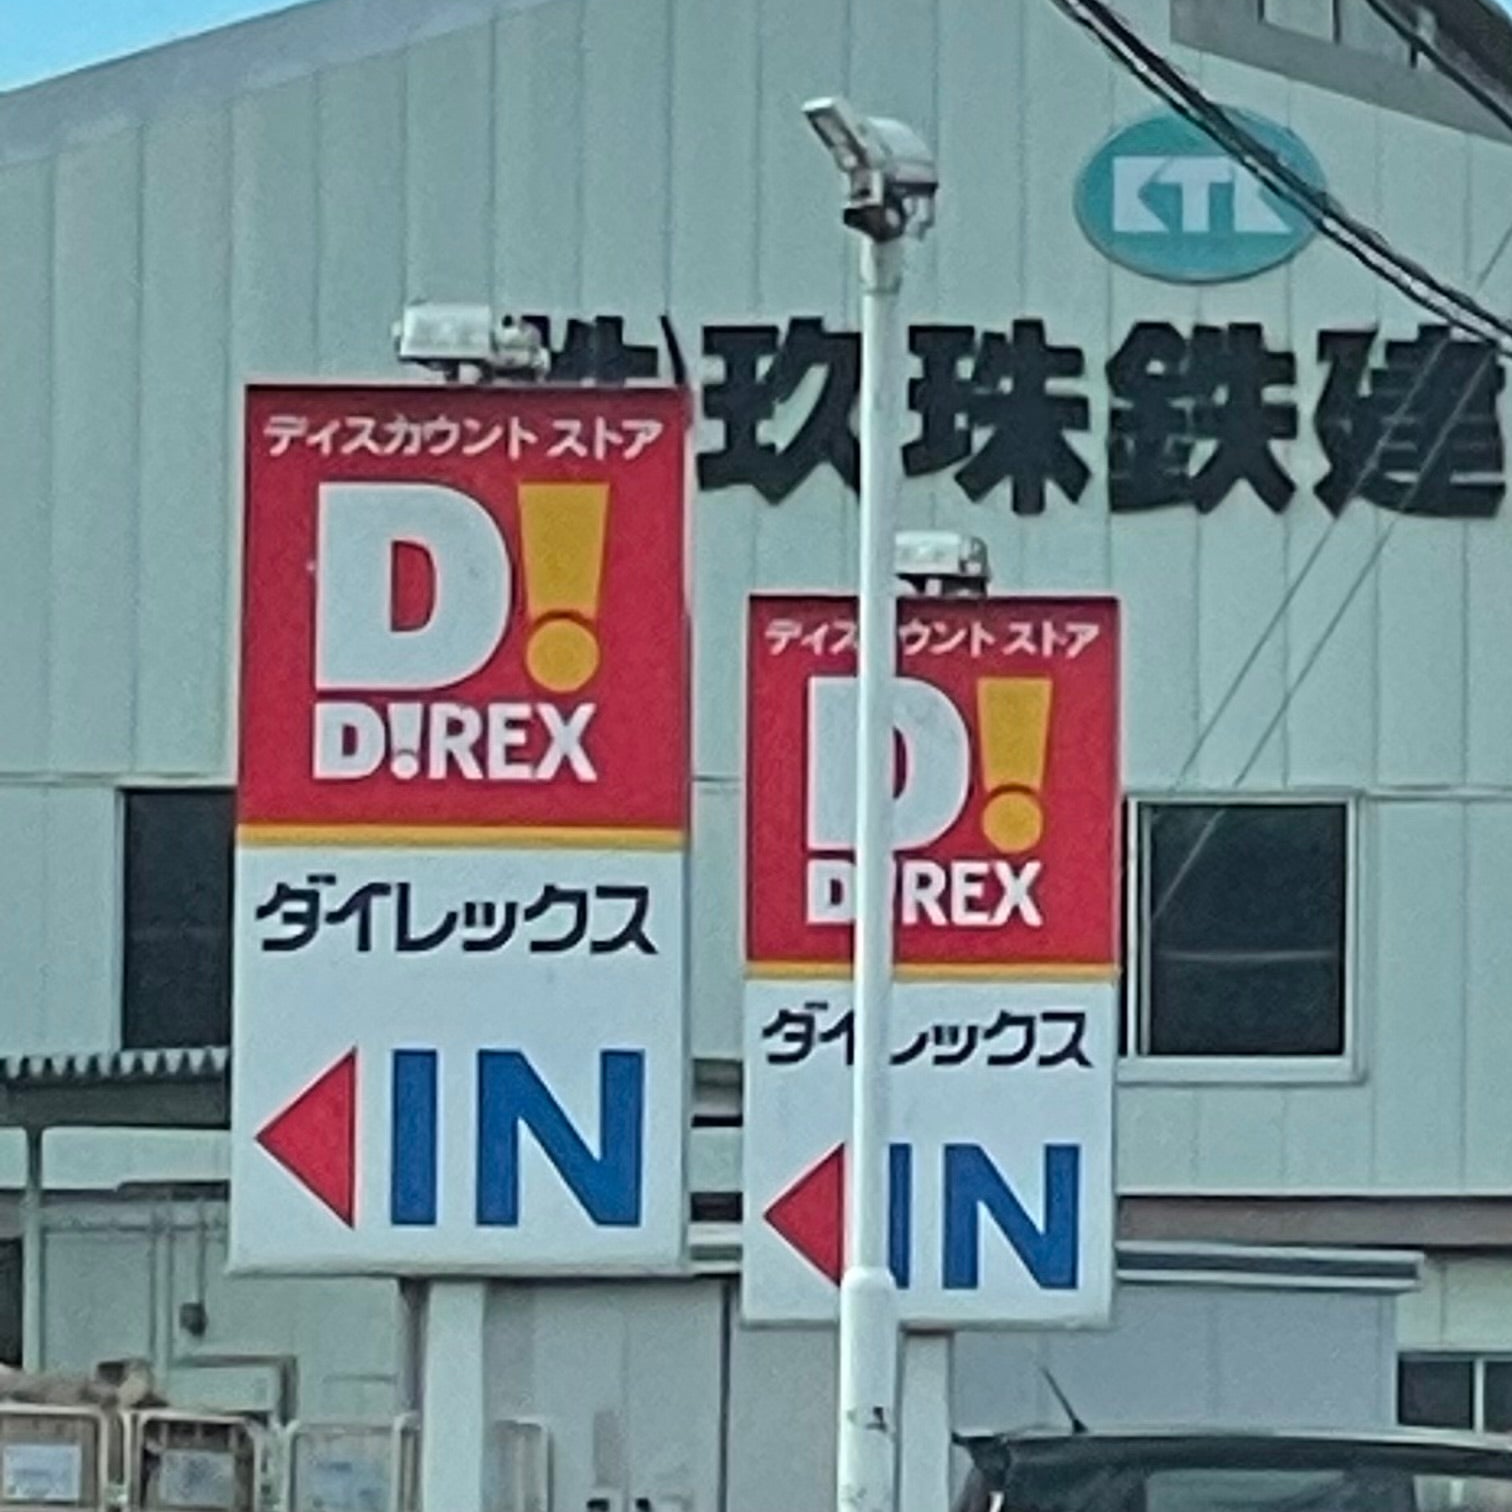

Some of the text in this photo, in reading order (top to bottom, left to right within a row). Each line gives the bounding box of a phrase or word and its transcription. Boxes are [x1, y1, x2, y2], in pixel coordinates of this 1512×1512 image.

[265, 415, 663, 459] ディスカウント ストア
[764, 618, 1099, 659] ディスウント ストア
[313, 703, 597, 780] D!REX
[255, 878, 658, 955] ダイレックス
[806, 859, 1043, 926] DREX
[390, 1049, 644, 1227] IN
